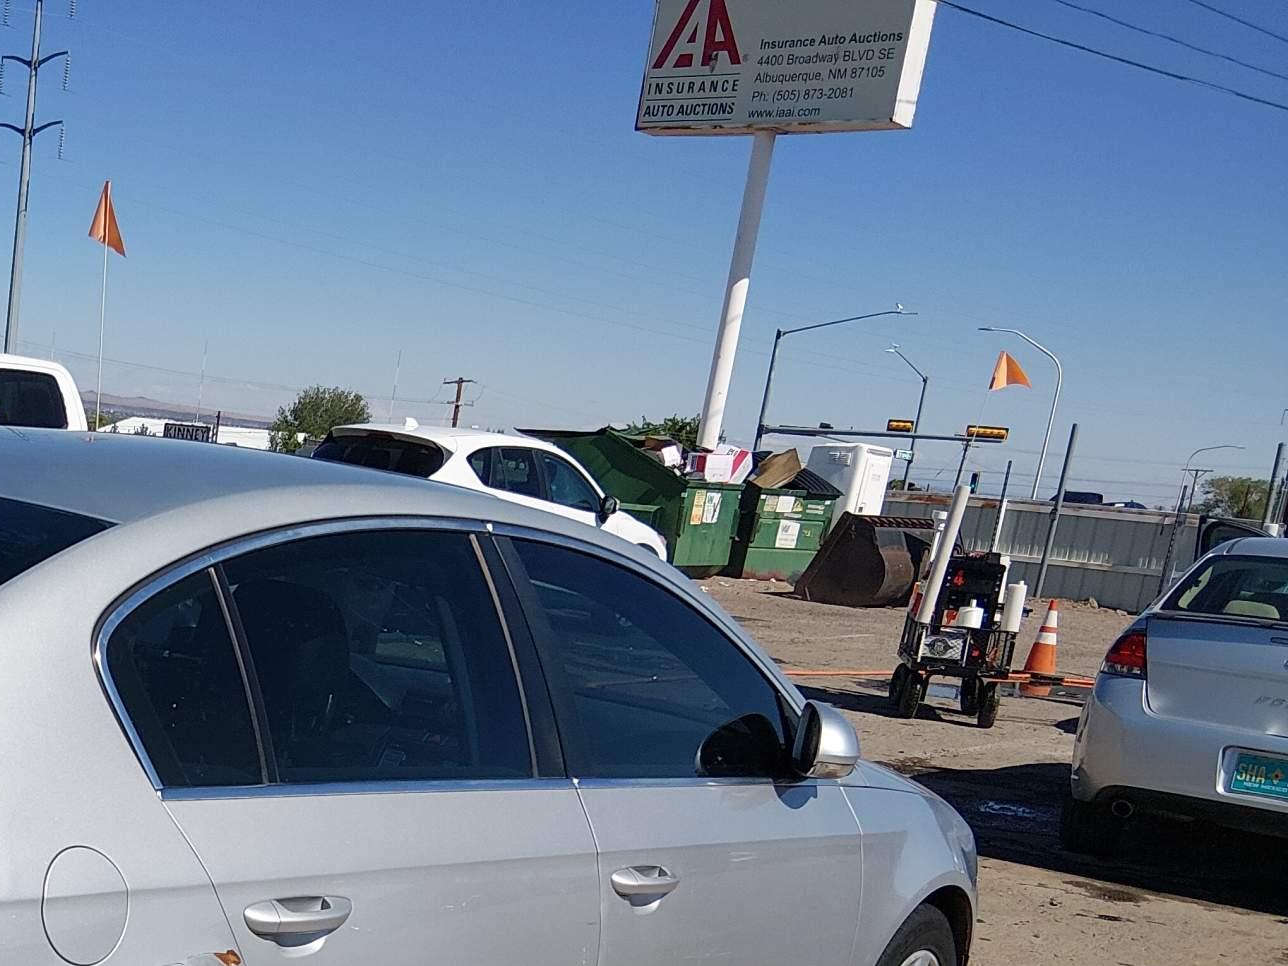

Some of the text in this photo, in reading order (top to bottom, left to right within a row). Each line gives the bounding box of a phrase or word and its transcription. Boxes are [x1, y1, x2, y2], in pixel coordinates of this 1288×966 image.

[759, 31, 904, 50] Insurance Auto Auctions
[757, 47, 896, 66] 4400 Broadway BLVD SE
[754, 66, 886, 86] Albuquerque, NM 87105
[647, 80, 740, 96] INSURANCE
[772, 89, 801, 104] (505)
[803, 87, 854, 100] 873-2081
[643, 102, 736, 118] AUTO AUCTIONS
[748, 106, 821, 119] www.iaai.com
